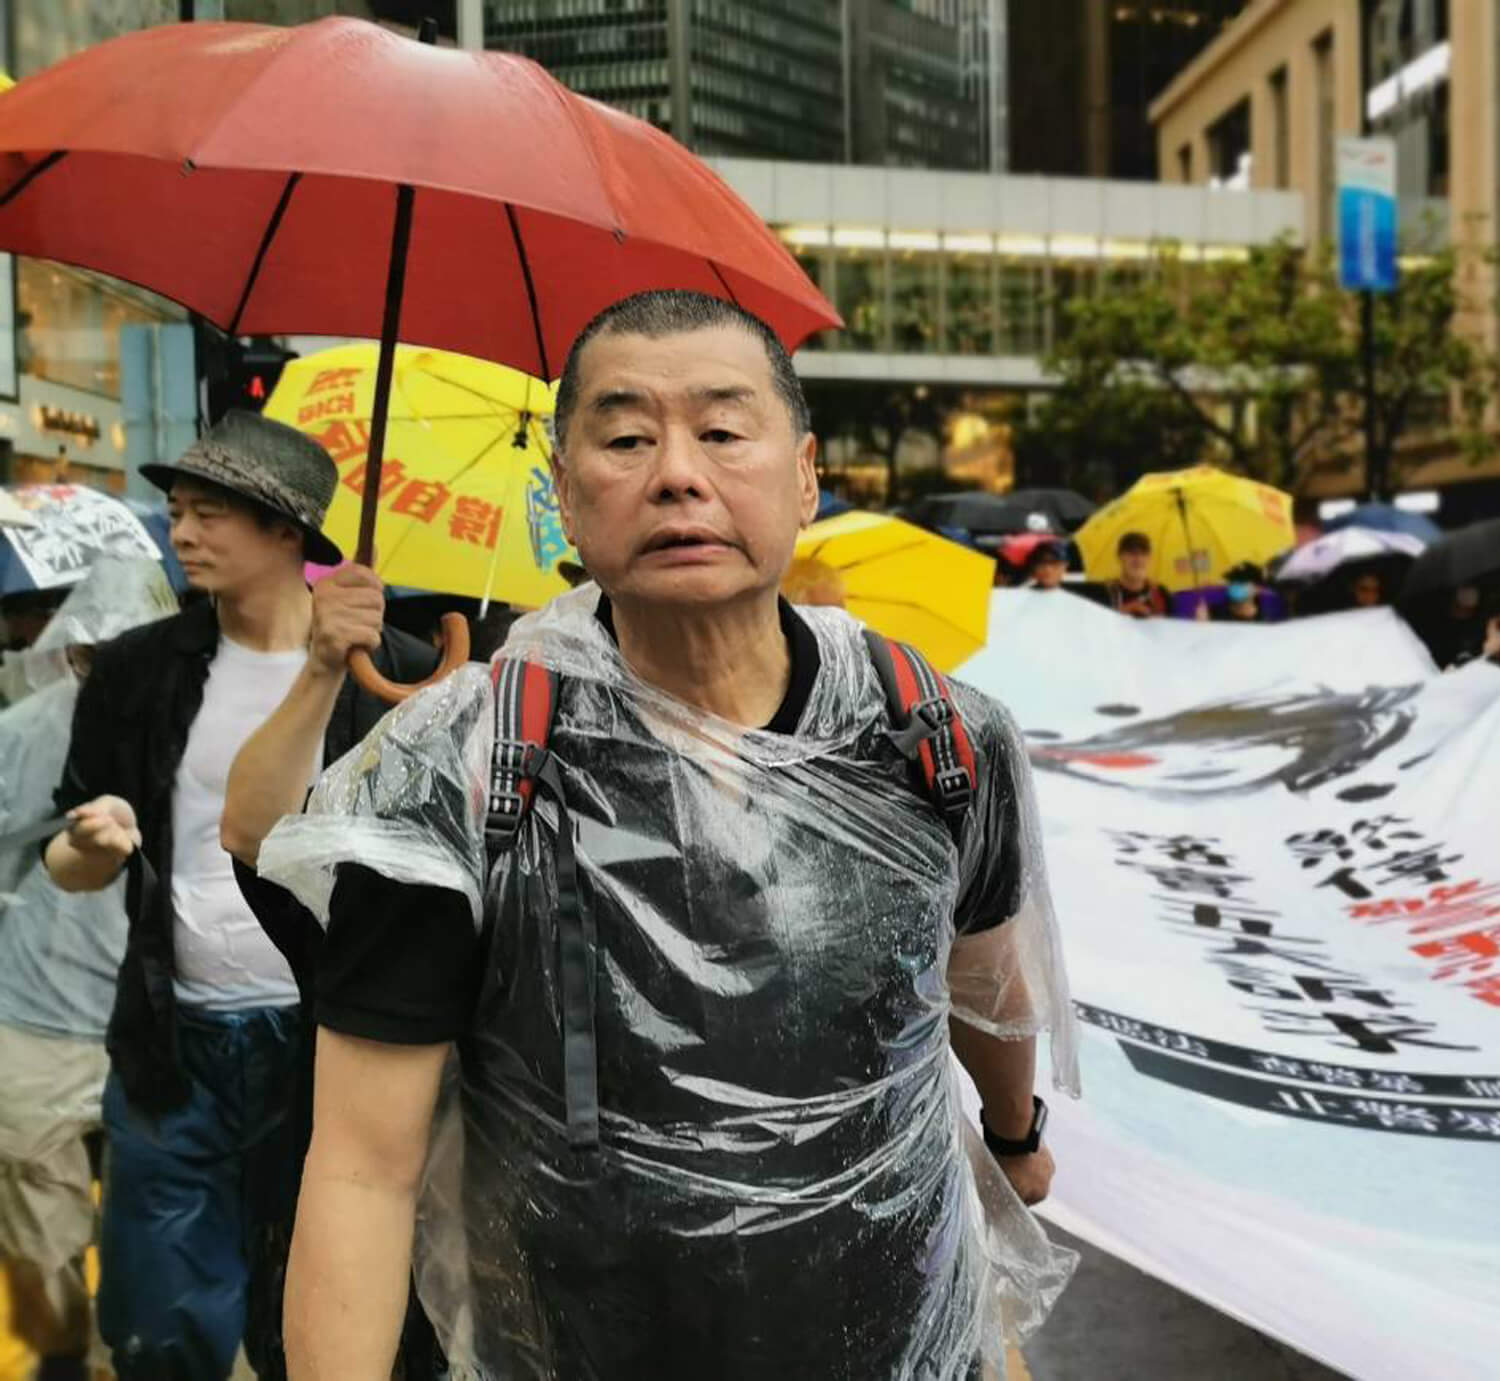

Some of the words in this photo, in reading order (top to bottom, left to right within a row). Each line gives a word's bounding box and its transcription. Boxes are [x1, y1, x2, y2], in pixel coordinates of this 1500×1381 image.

[1098, 828, 1480, 1055] 落實五大訴求
